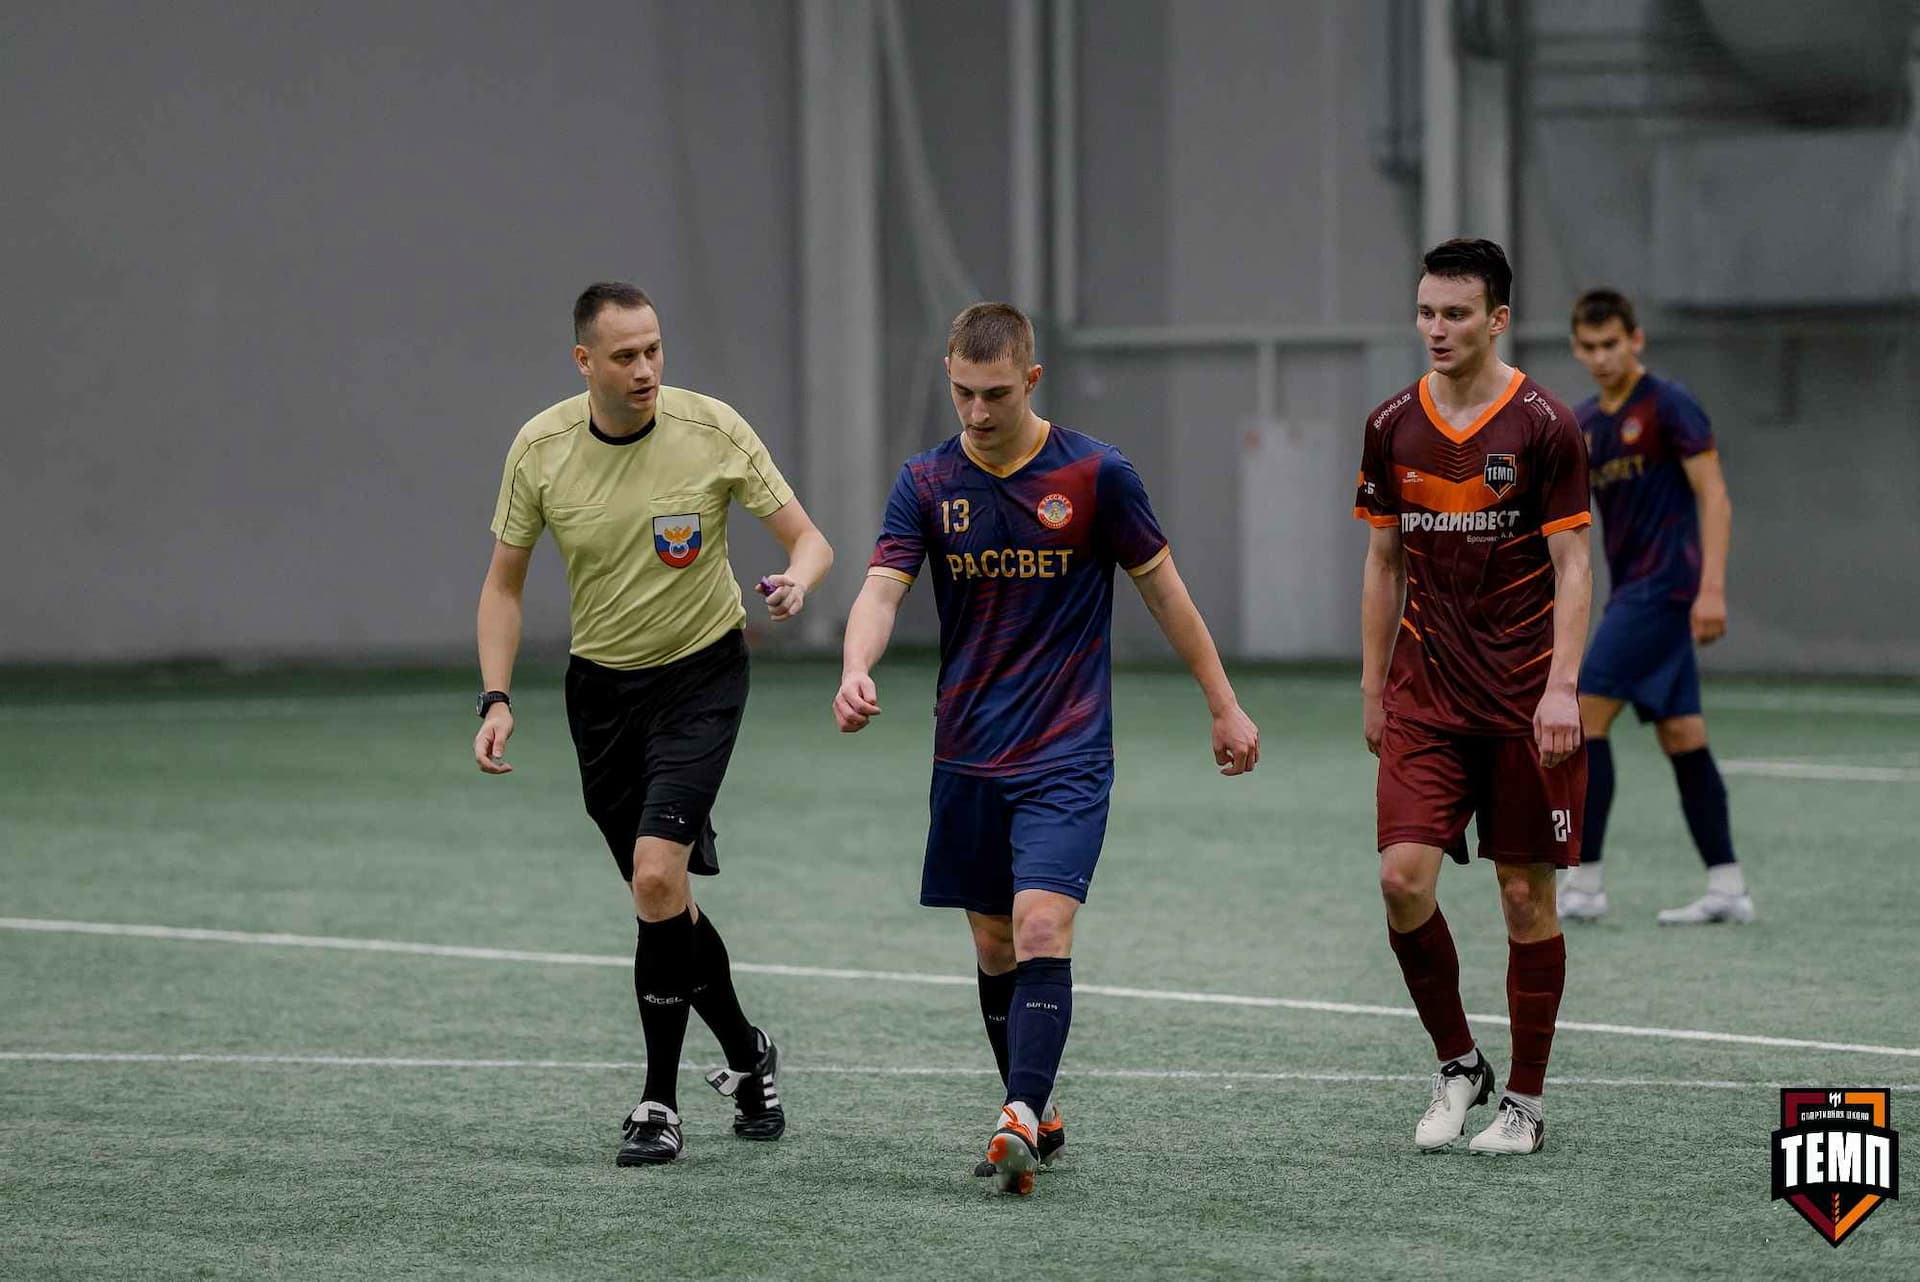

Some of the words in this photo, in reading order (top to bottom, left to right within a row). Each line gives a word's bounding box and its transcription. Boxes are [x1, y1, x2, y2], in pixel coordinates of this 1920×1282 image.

[1487, 466, 1514, 482] ТЕМП
[941, 498, 970, 534] 13
[1401, 510, 1521, 534] ПРОДИНВЕСТ
[946, 548, 1073, 581] РАССВЕТ
